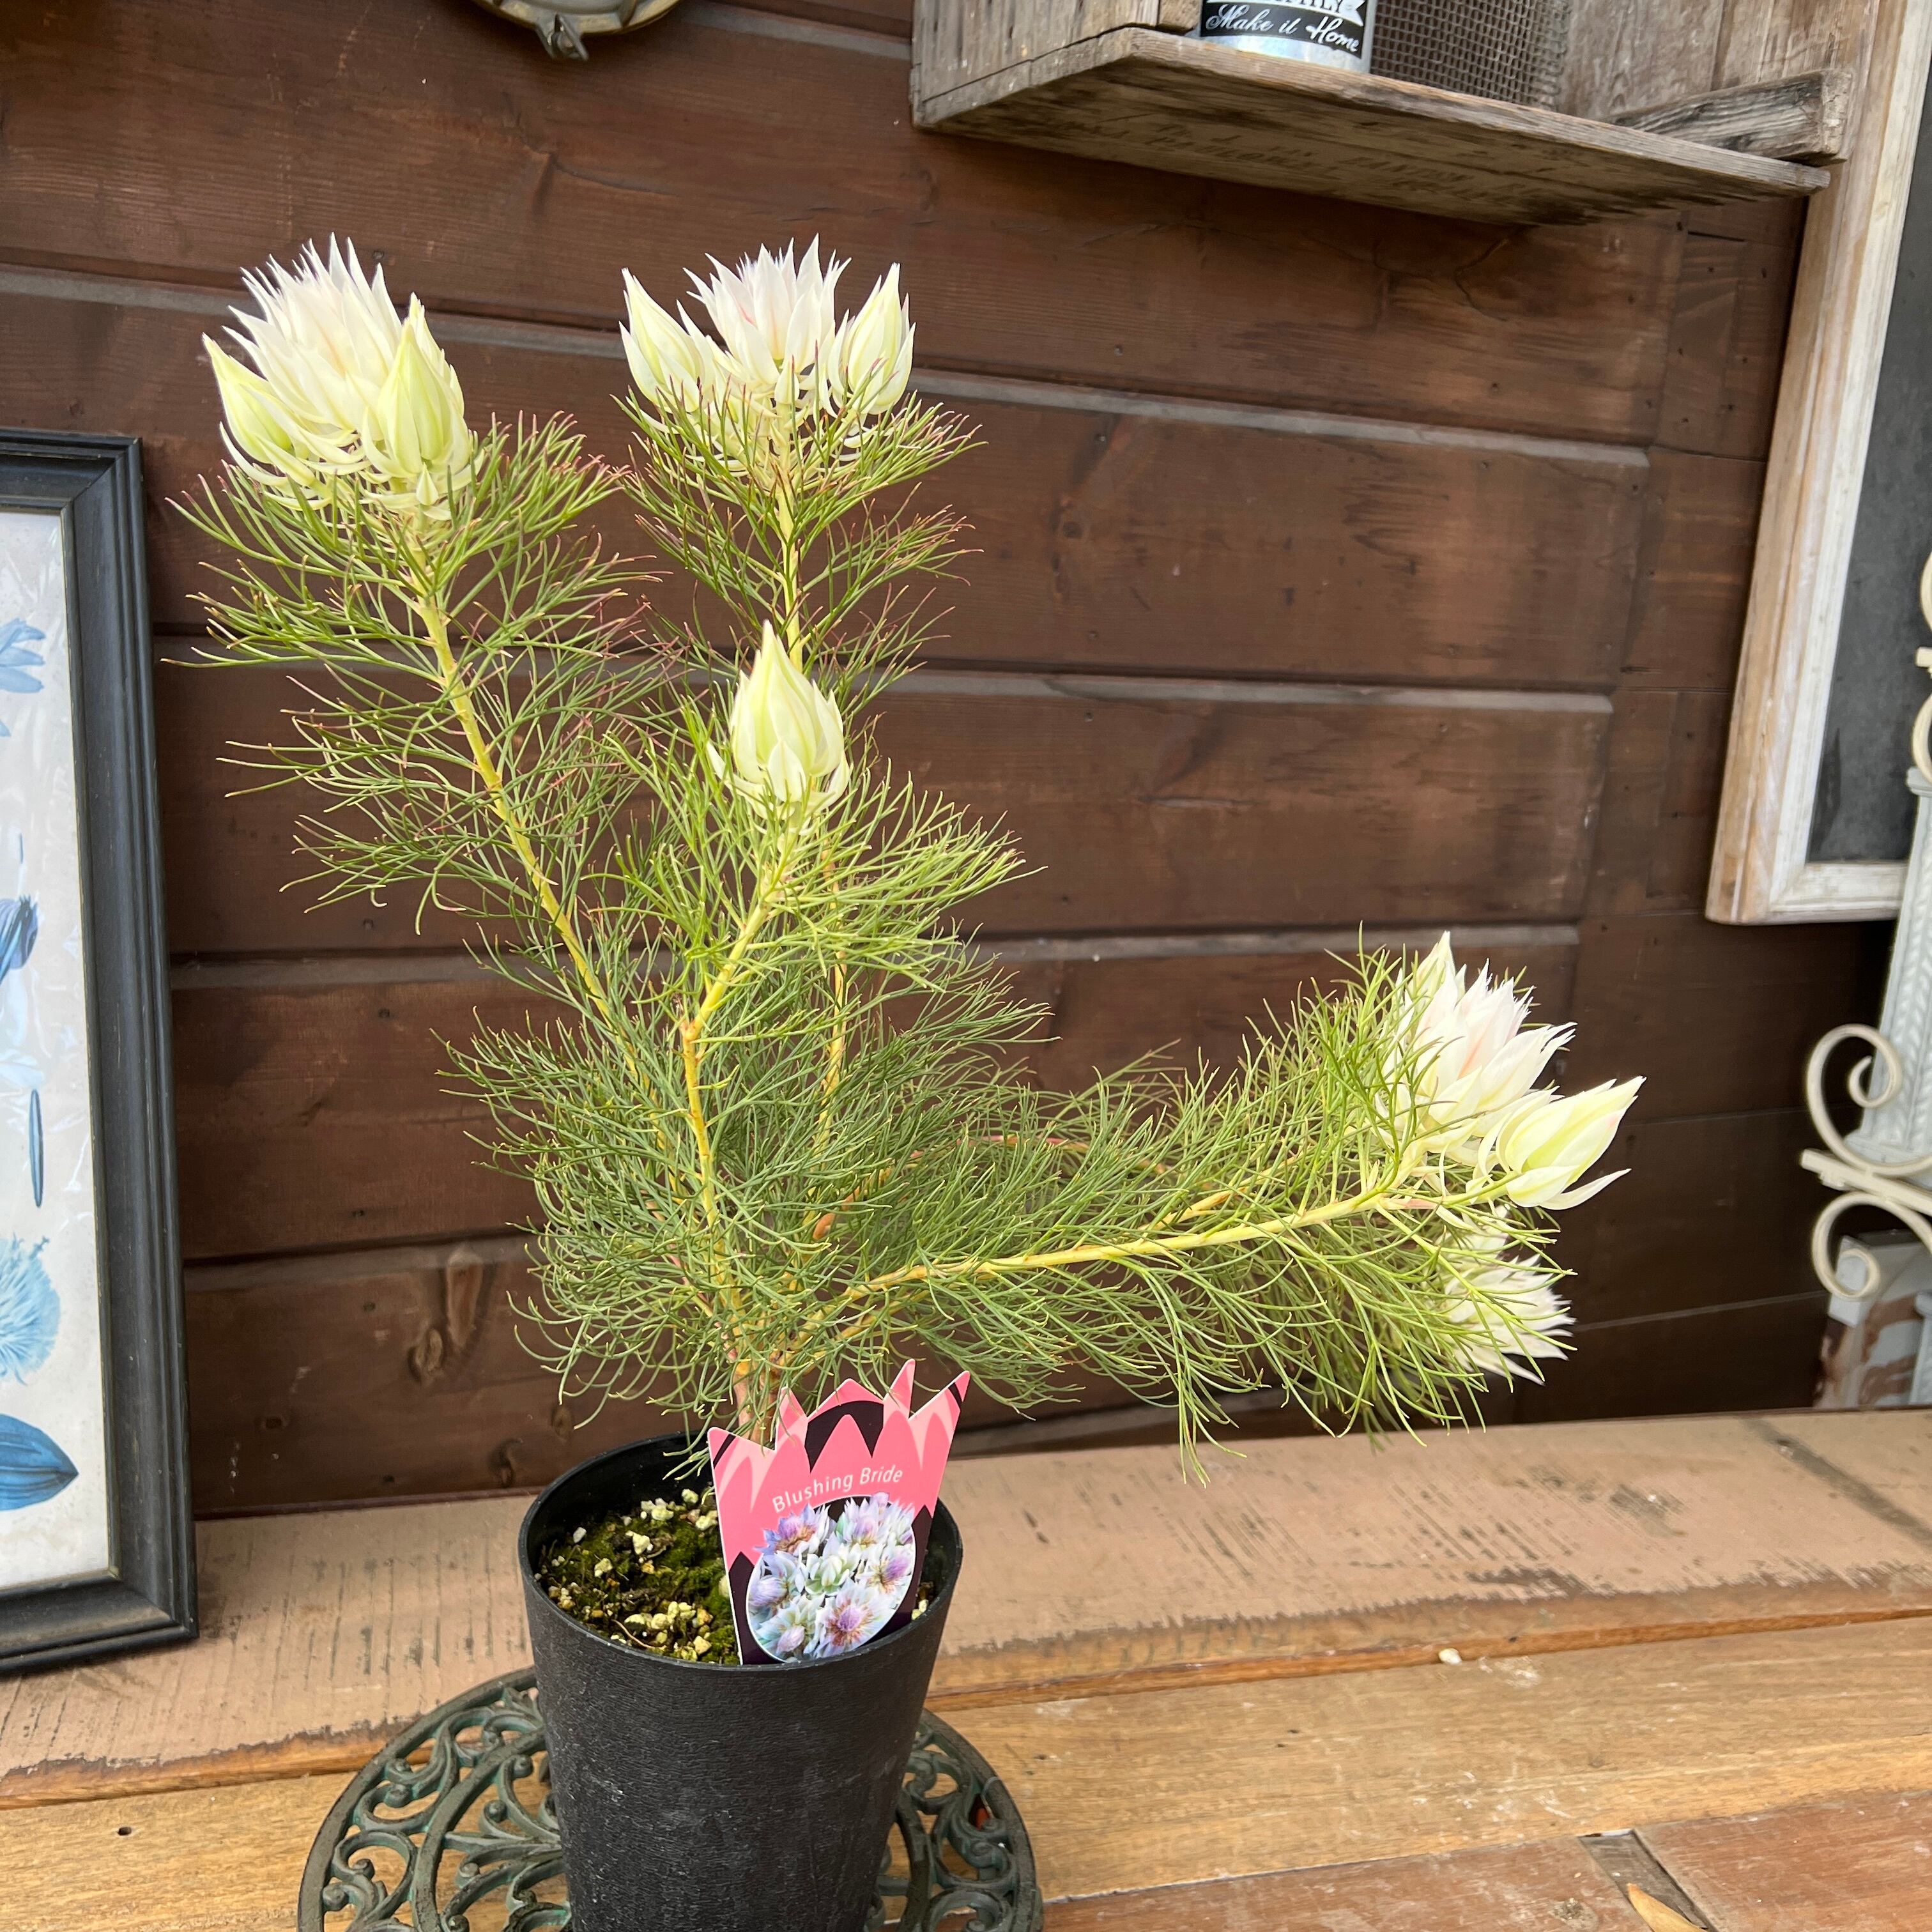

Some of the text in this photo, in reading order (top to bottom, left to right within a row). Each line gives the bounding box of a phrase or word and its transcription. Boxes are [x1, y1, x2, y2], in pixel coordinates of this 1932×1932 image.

[1206, 4, 1273, 31] Make
[1278, 18, 1301, 34] it
[1305, 15, 1360, 52] Home
[772, 1464, 903, 1513] Blushing Bride
